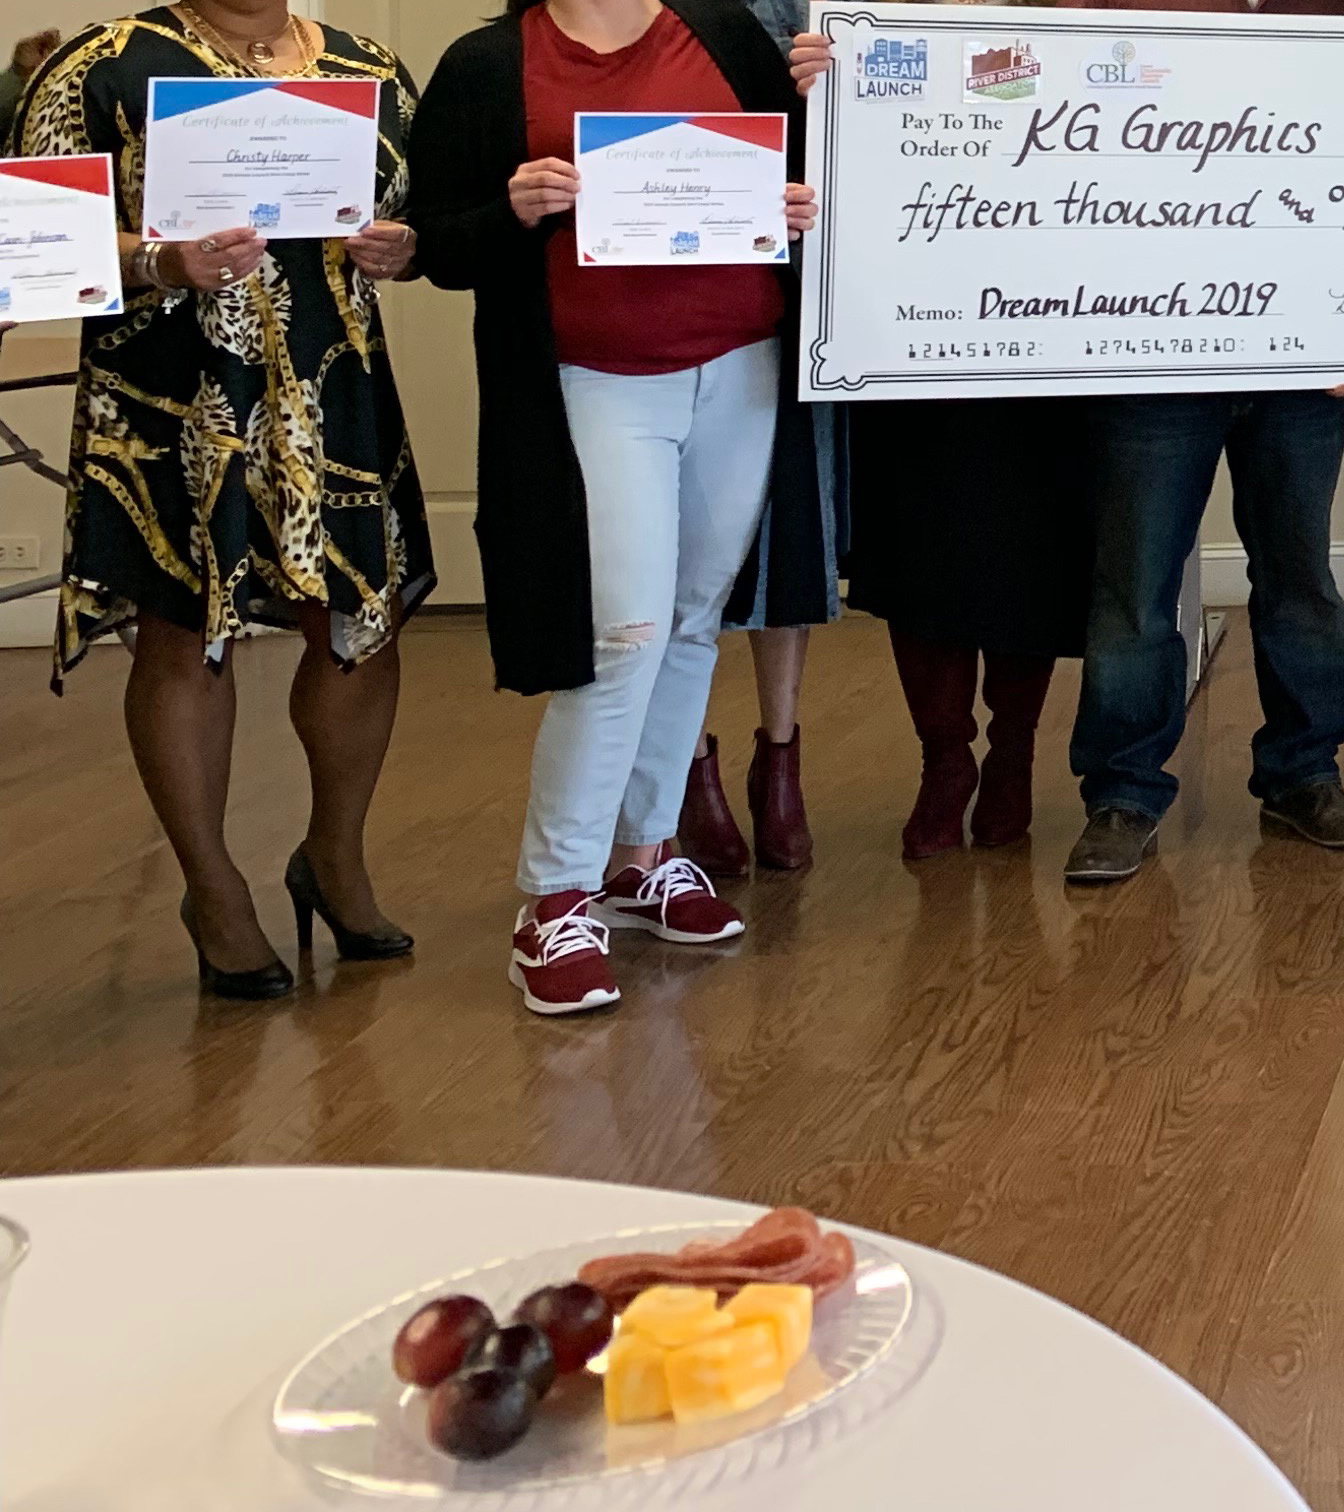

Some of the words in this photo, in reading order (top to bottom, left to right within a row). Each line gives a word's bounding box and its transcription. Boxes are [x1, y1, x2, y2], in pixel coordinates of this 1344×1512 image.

[866, 62, 925, 79] DREAM
[968, 74, 996, 89] RIVER
[998, 65, 1039, 82] DISTRICT
[1086, 64, 1136, 83] CBL
[856, 80, 922, 98] LAUNCH
[182, 114, 250, 130] Certificate
[900, 113, 934, 134] Pay
[939, 113, 963, 130] To
[968, 113, 1004, 131] The
[900, 139, 958, 158] Order
[962, 139, 991, 157] Of
[1011, 100, 1101, 167] KG
[1120, 104, 1322, 173] Graphics
[226, 149, 269, 167] Christy
[272, 149, 311, 165] Harper
[605, 148, 666, 161] Certificate
[680, 182, 711, 197] Henry
[897, 181, 1044, 242] fifteen
[1054, 180, 1263, 229] thousand
[1278, 188, 1315, 223] and
[896, 305, 964, 322] Memo:
[1196, 281, 1279, 317] 2019
